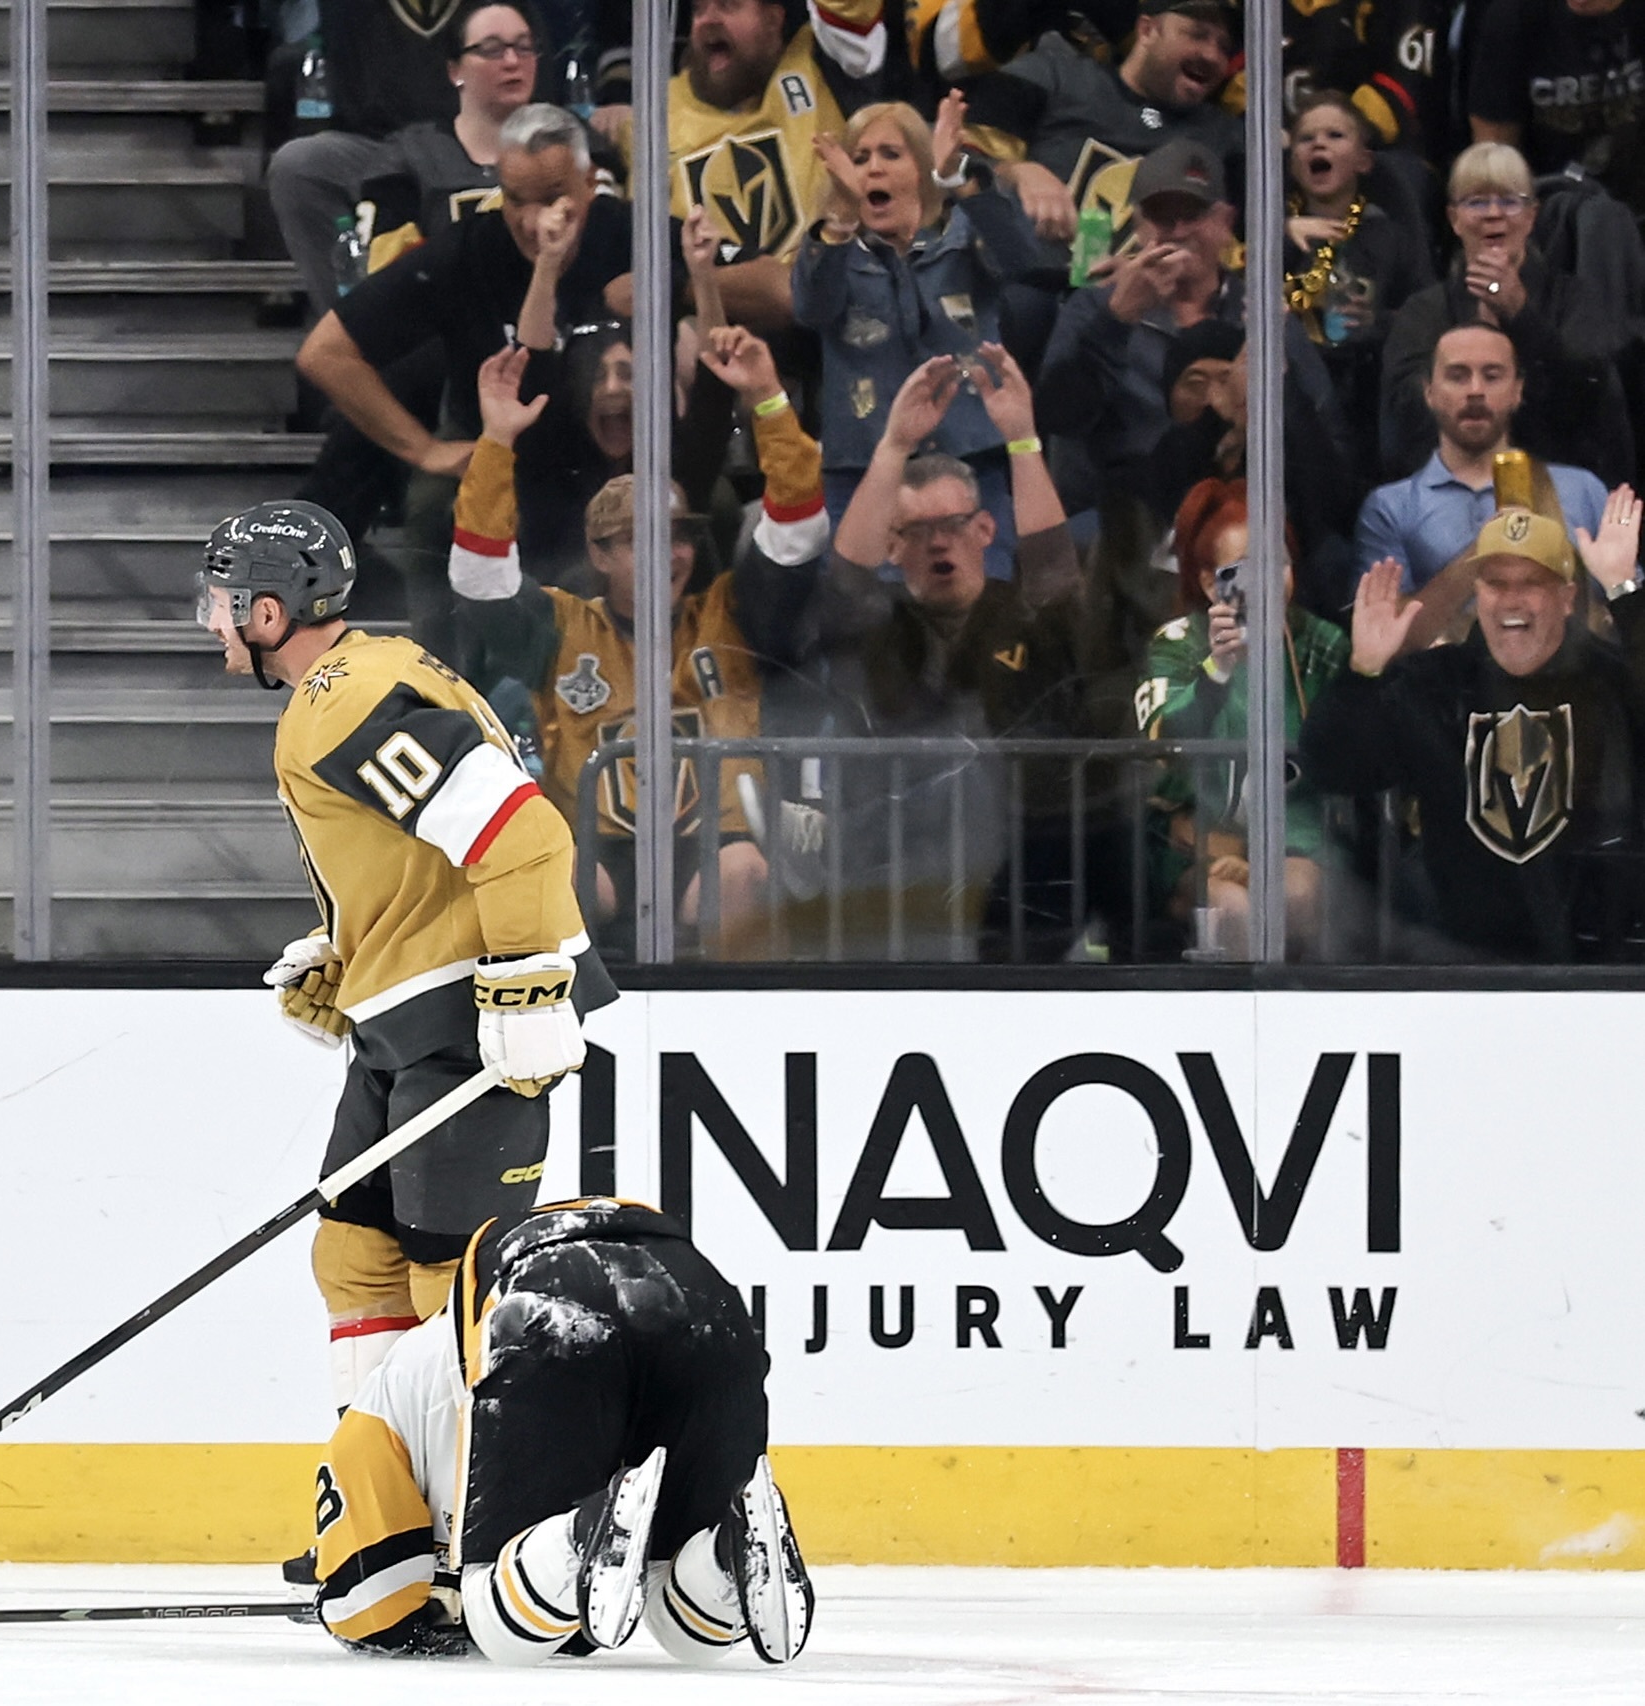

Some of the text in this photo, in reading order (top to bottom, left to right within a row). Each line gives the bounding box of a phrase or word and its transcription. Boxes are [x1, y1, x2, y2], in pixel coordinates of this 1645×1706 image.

[1398, 25, 1435, 77] 61
[780, 75, 812, 113] A
[1134, 677, 1169, 731] 61
[356, 731, 442, 820] 10
[475, 980, 568, 1006] CCM
[500, 1161, 544, 1184] CC
[737, 1285, 1398, 1354] JURY LAW
